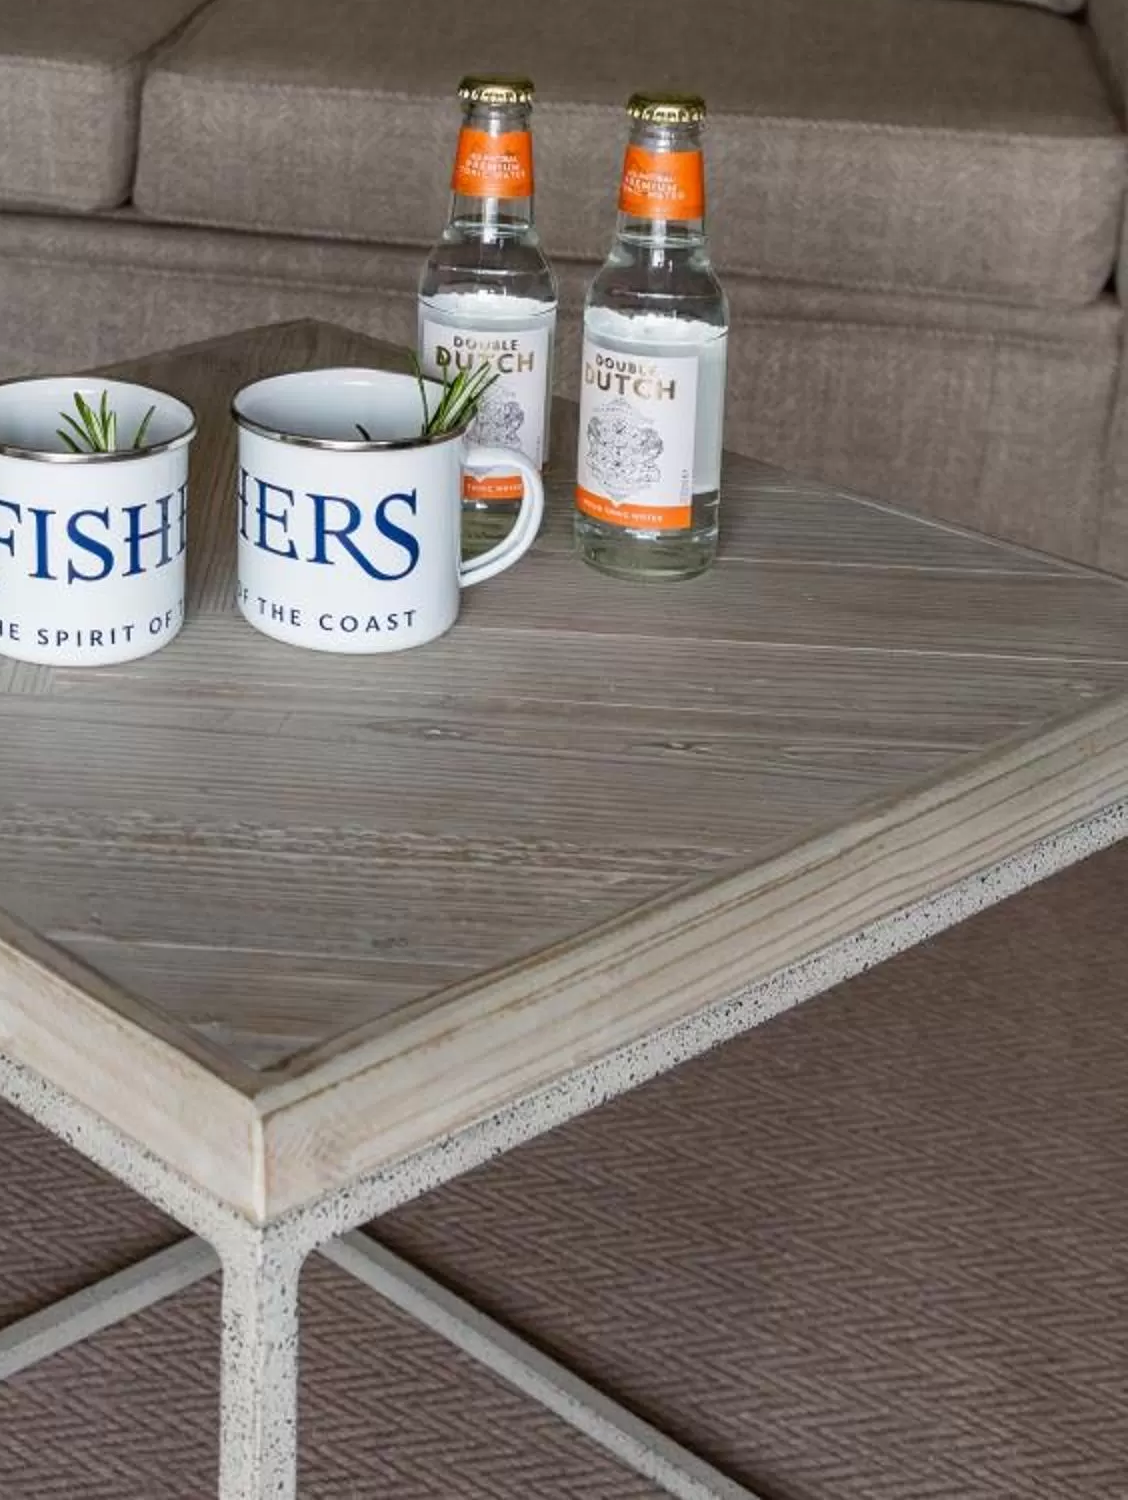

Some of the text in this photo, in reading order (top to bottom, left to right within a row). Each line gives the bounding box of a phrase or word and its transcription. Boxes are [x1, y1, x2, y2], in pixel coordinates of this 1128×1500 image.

[436, 345, 534, 373] DUTCH
[453, 336, 520, 351] DOUBLE
[585, 361, 676, 401] DUTCH
[37, 624, 135, 647] SPIRIT
[149, 609, 173, 635] OF
[258, 597, 302, 627] THE
[319, 610, 417, 632] COAST
